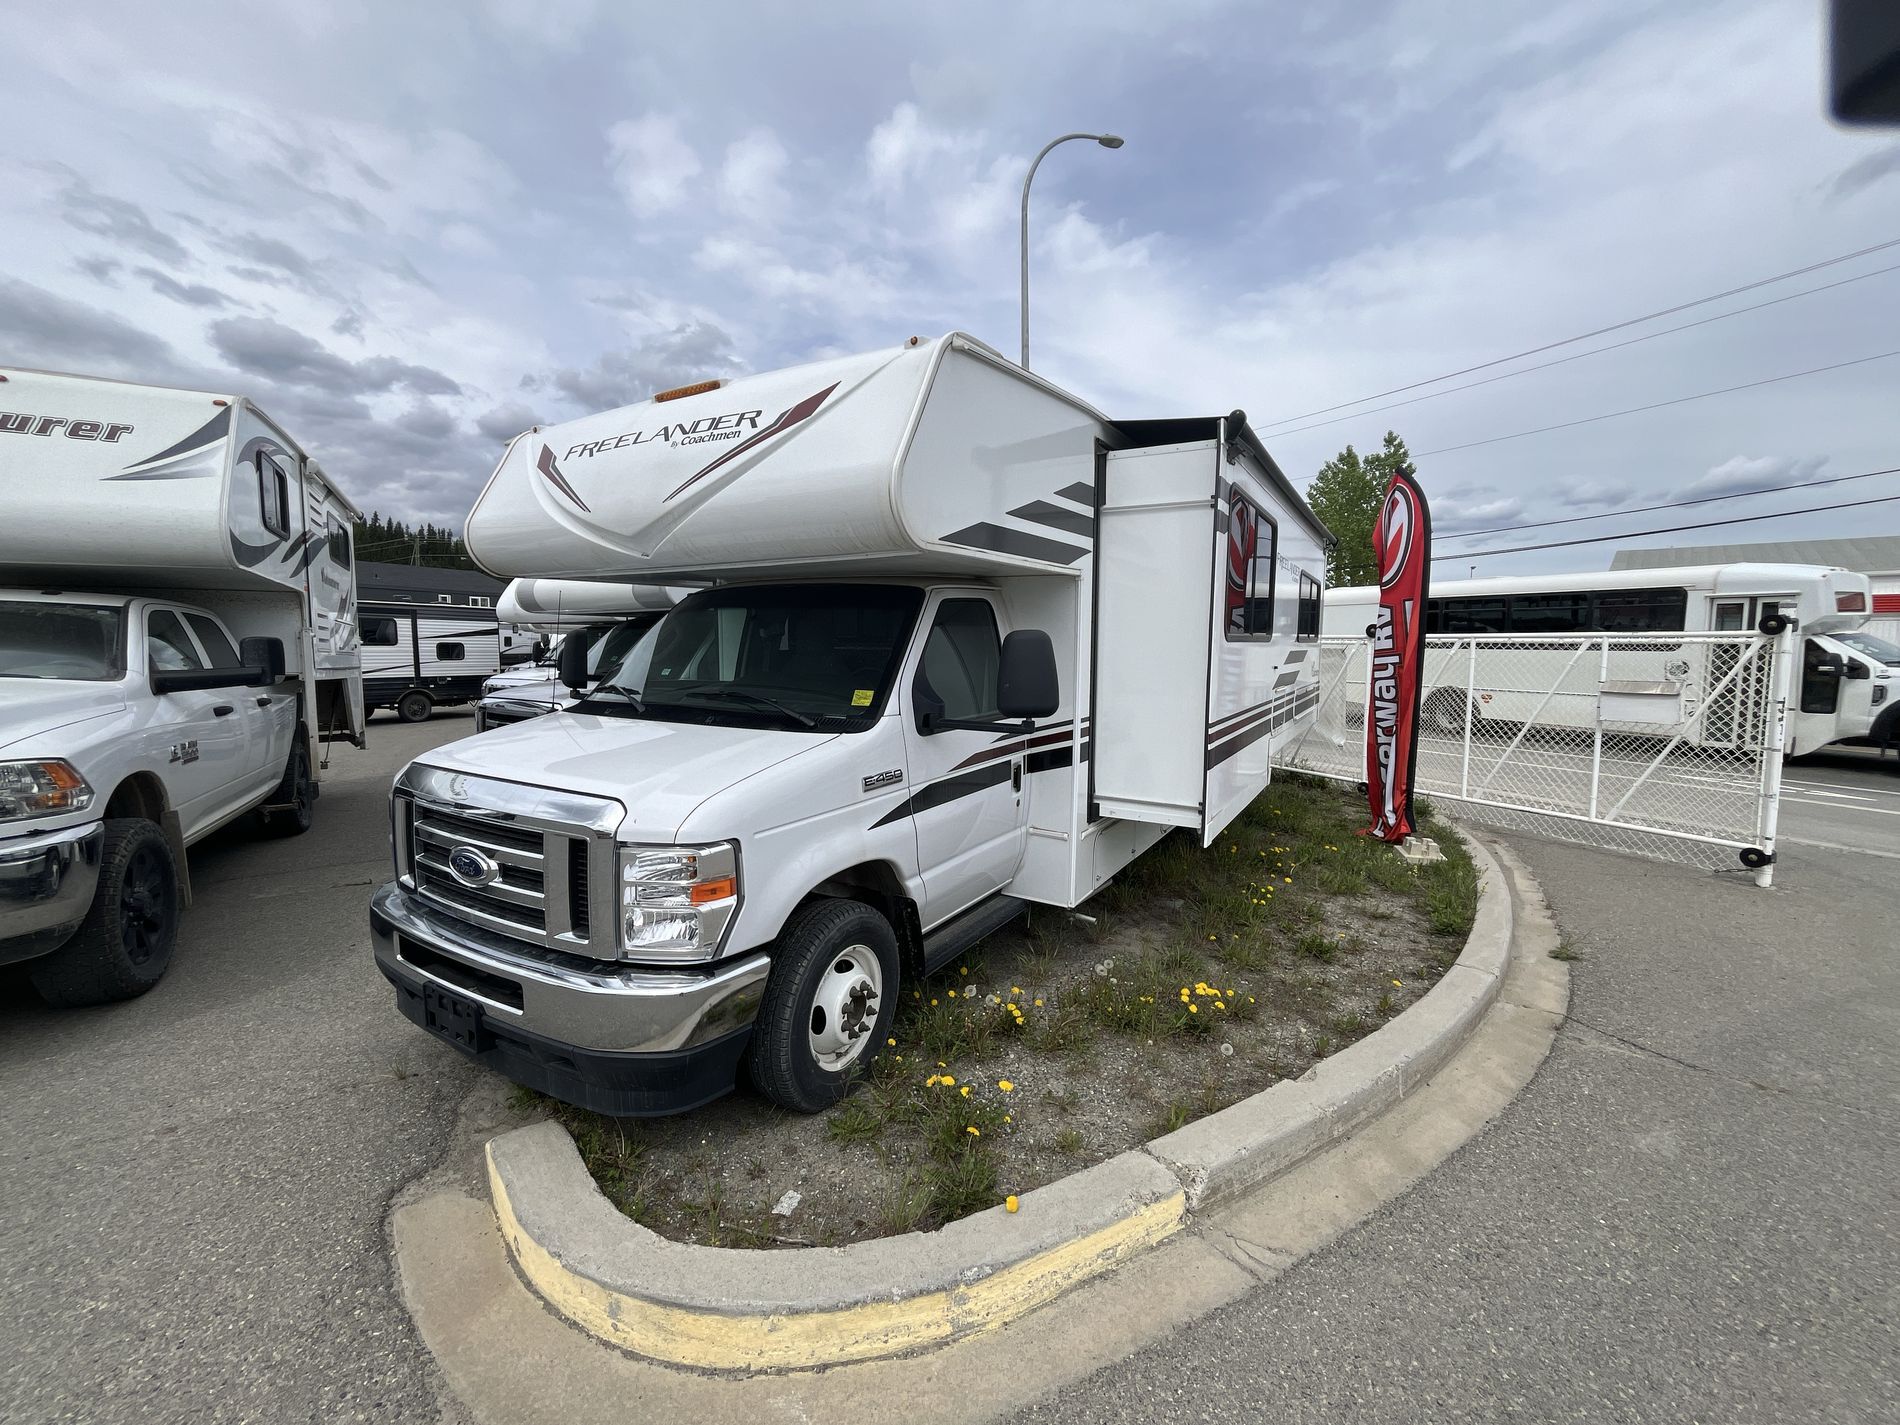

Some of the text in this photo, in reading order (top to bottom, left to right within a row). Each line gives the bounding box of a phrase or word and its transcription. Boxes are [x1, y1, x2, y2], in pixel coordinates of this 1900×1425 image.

[0, 411, 134, 443] urer
[563, 409, 762, 461] FREELANDER
[681, 430, 741, 447] Coachmen
